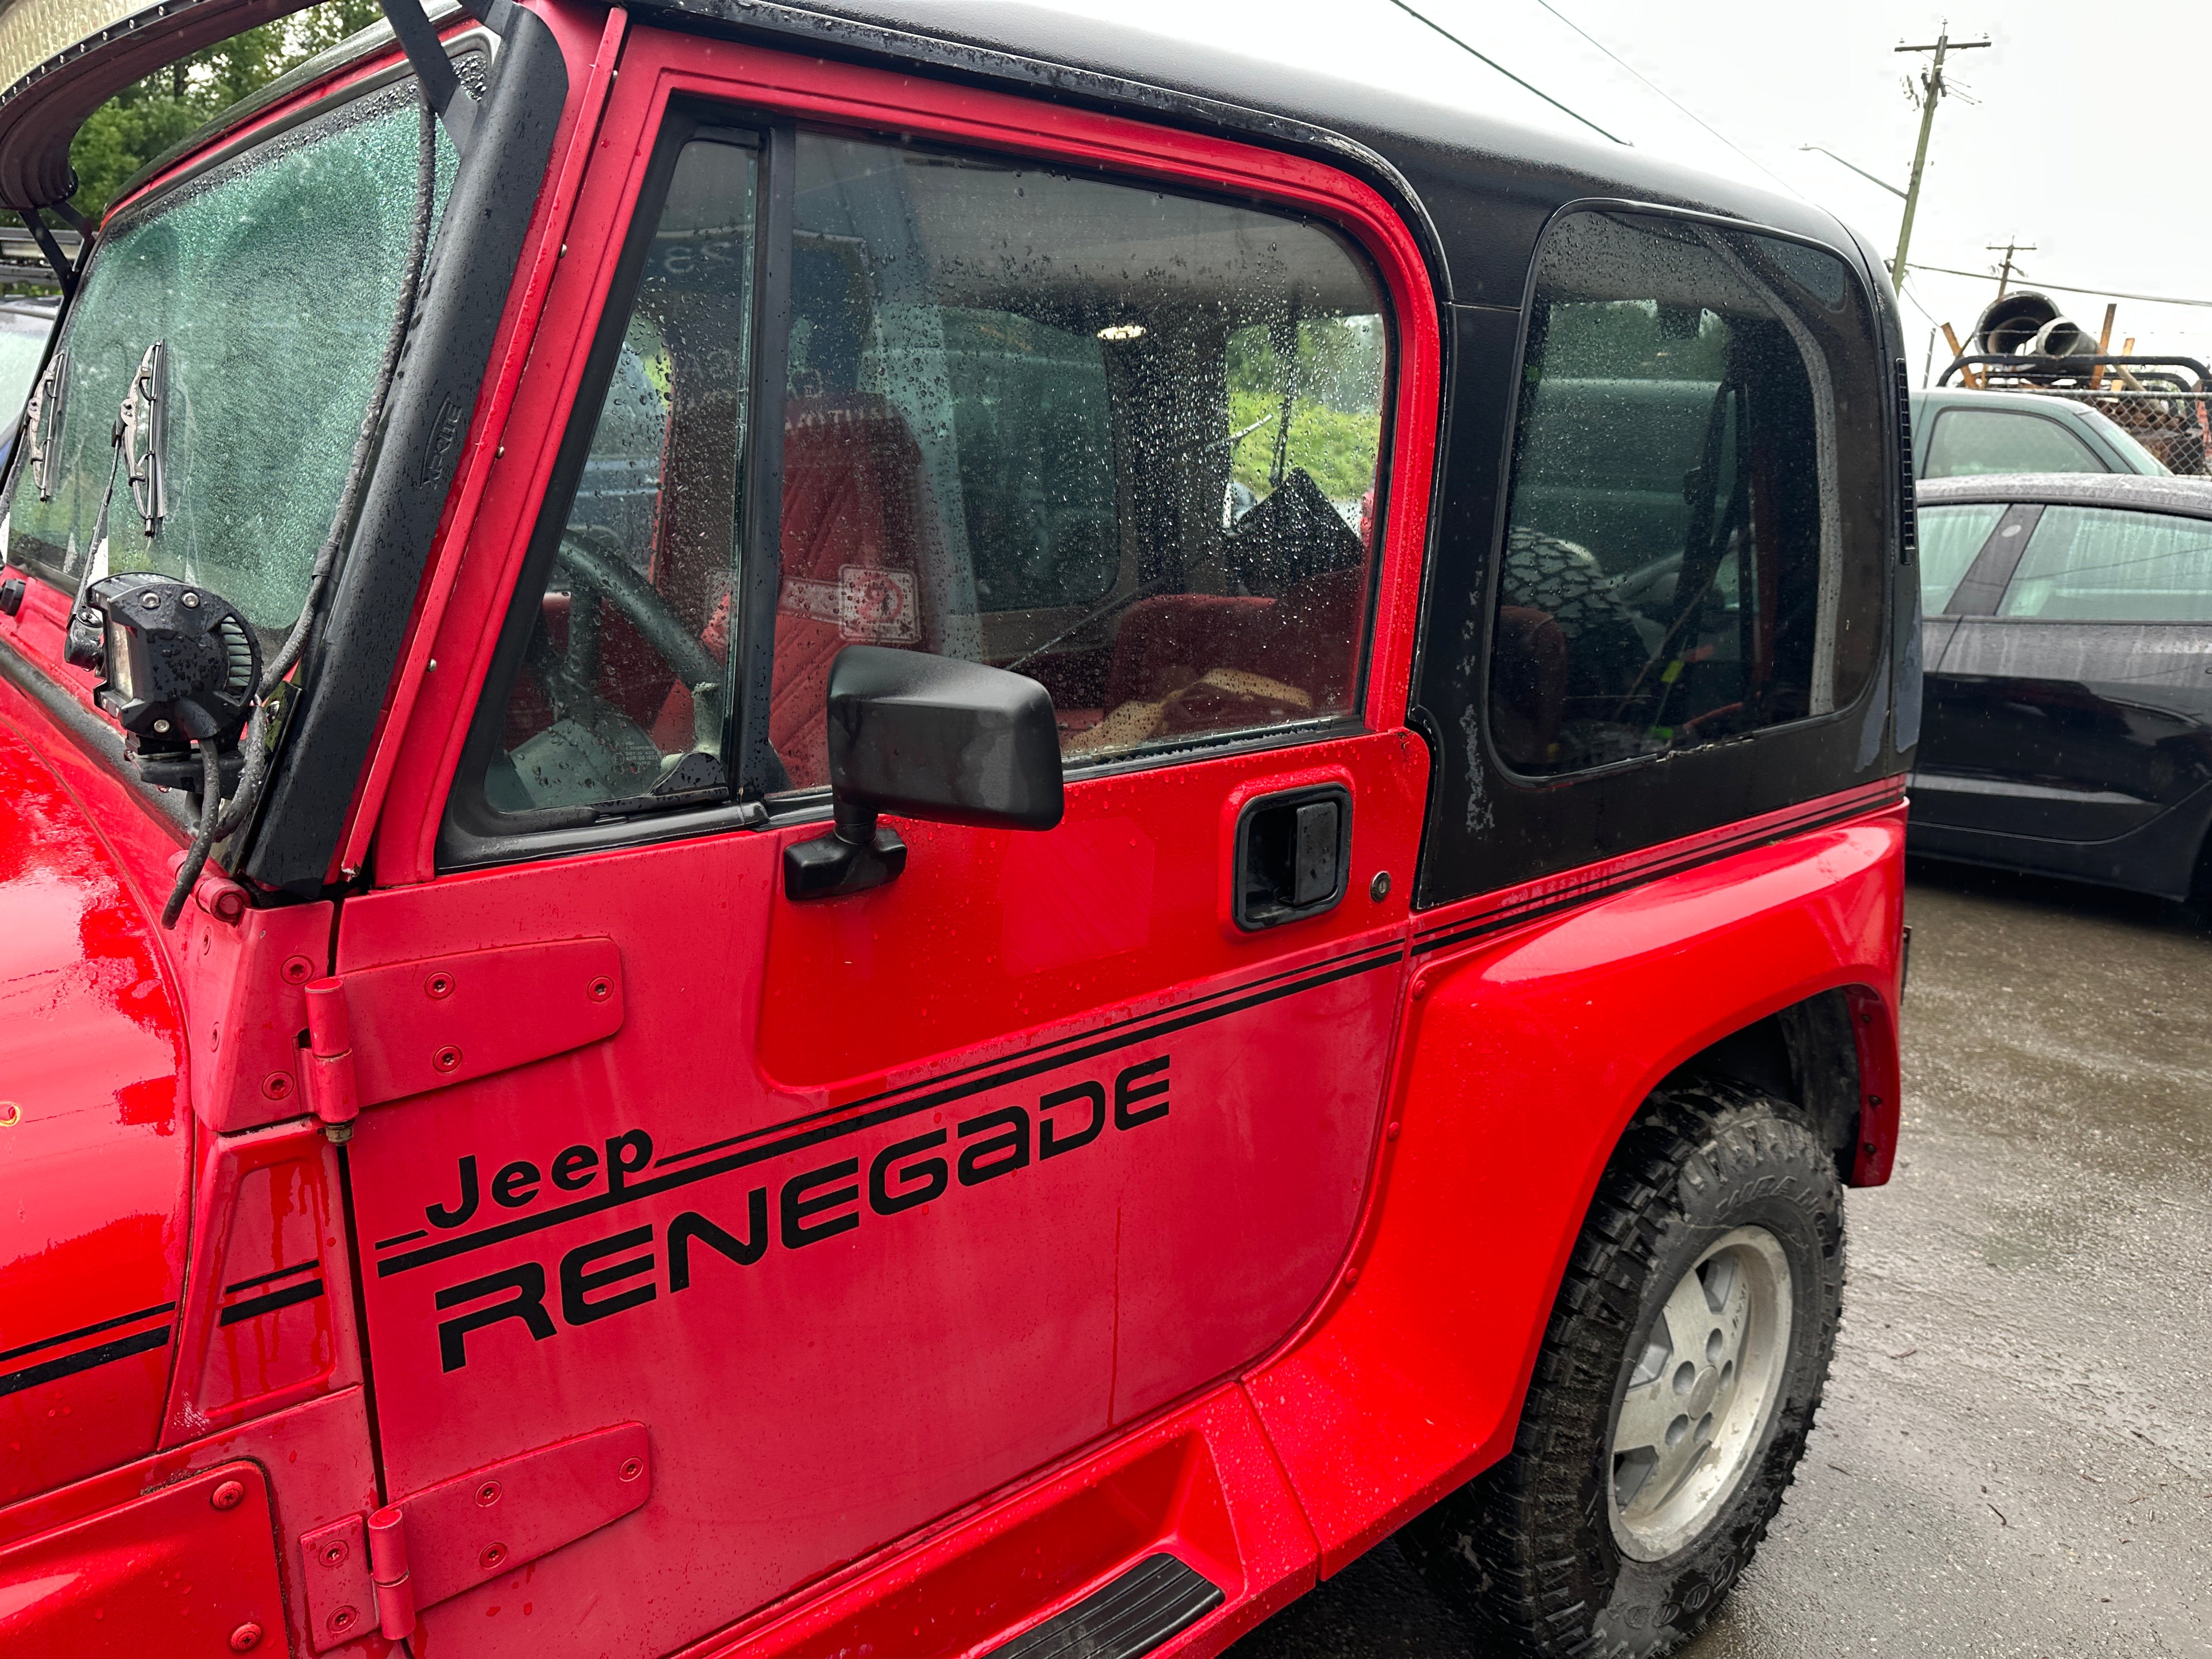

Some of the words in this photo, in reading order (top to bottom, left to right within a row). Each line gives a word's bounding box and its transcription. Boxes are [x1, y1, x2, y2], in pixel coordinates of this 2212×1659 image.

[423, 401, 463, 490] XPRITE
[426, 1128, 654, 1229] Jeep
[435, 1055, 1170, 1373] RENEGADE
